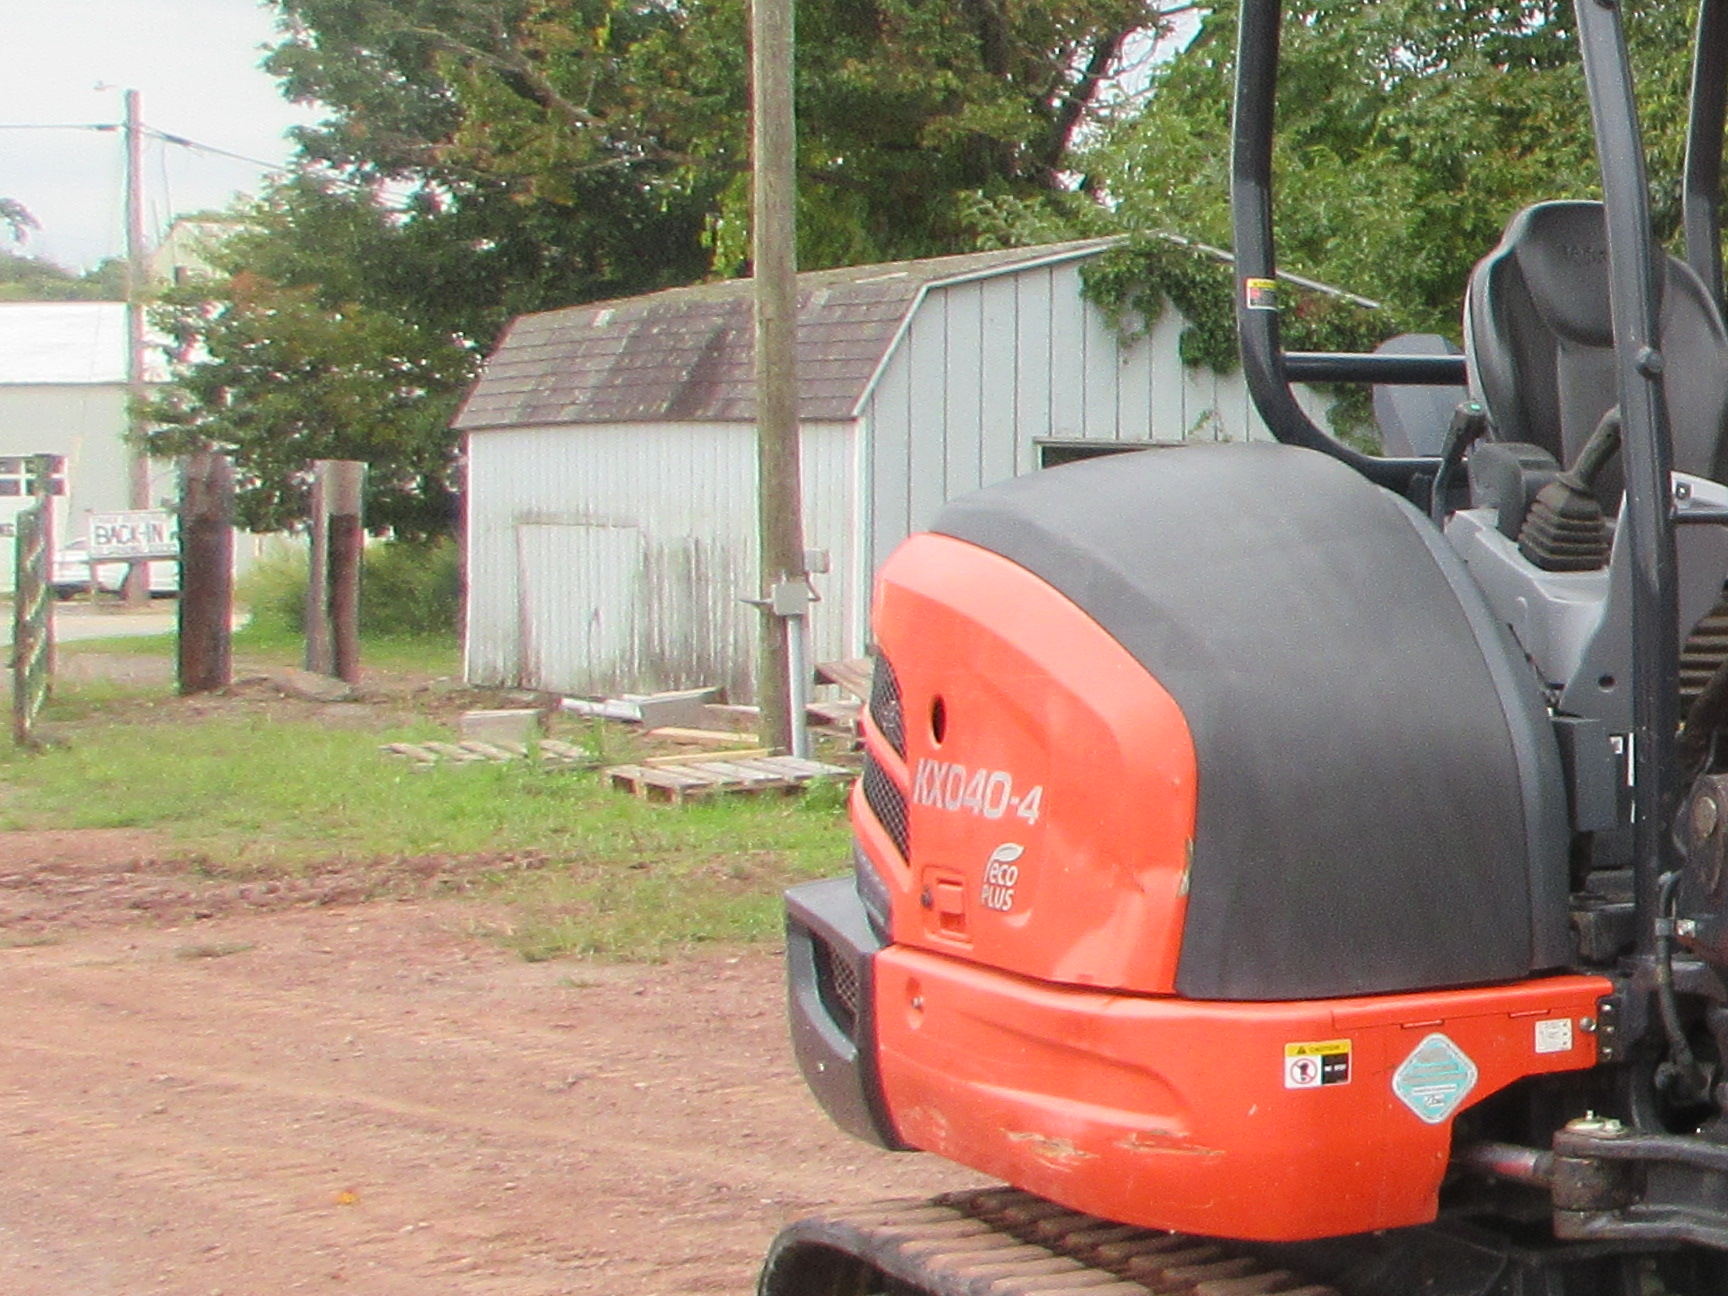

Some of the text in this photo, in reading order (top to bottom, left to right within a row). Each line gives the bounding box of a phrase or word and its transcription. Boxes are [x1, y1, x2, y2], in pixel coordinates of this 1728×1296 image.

[913, 757, 1044, 826] KX040-4
[989, 861, 1019, 888] eco
[981, 884, 1015, 912] PLUS
